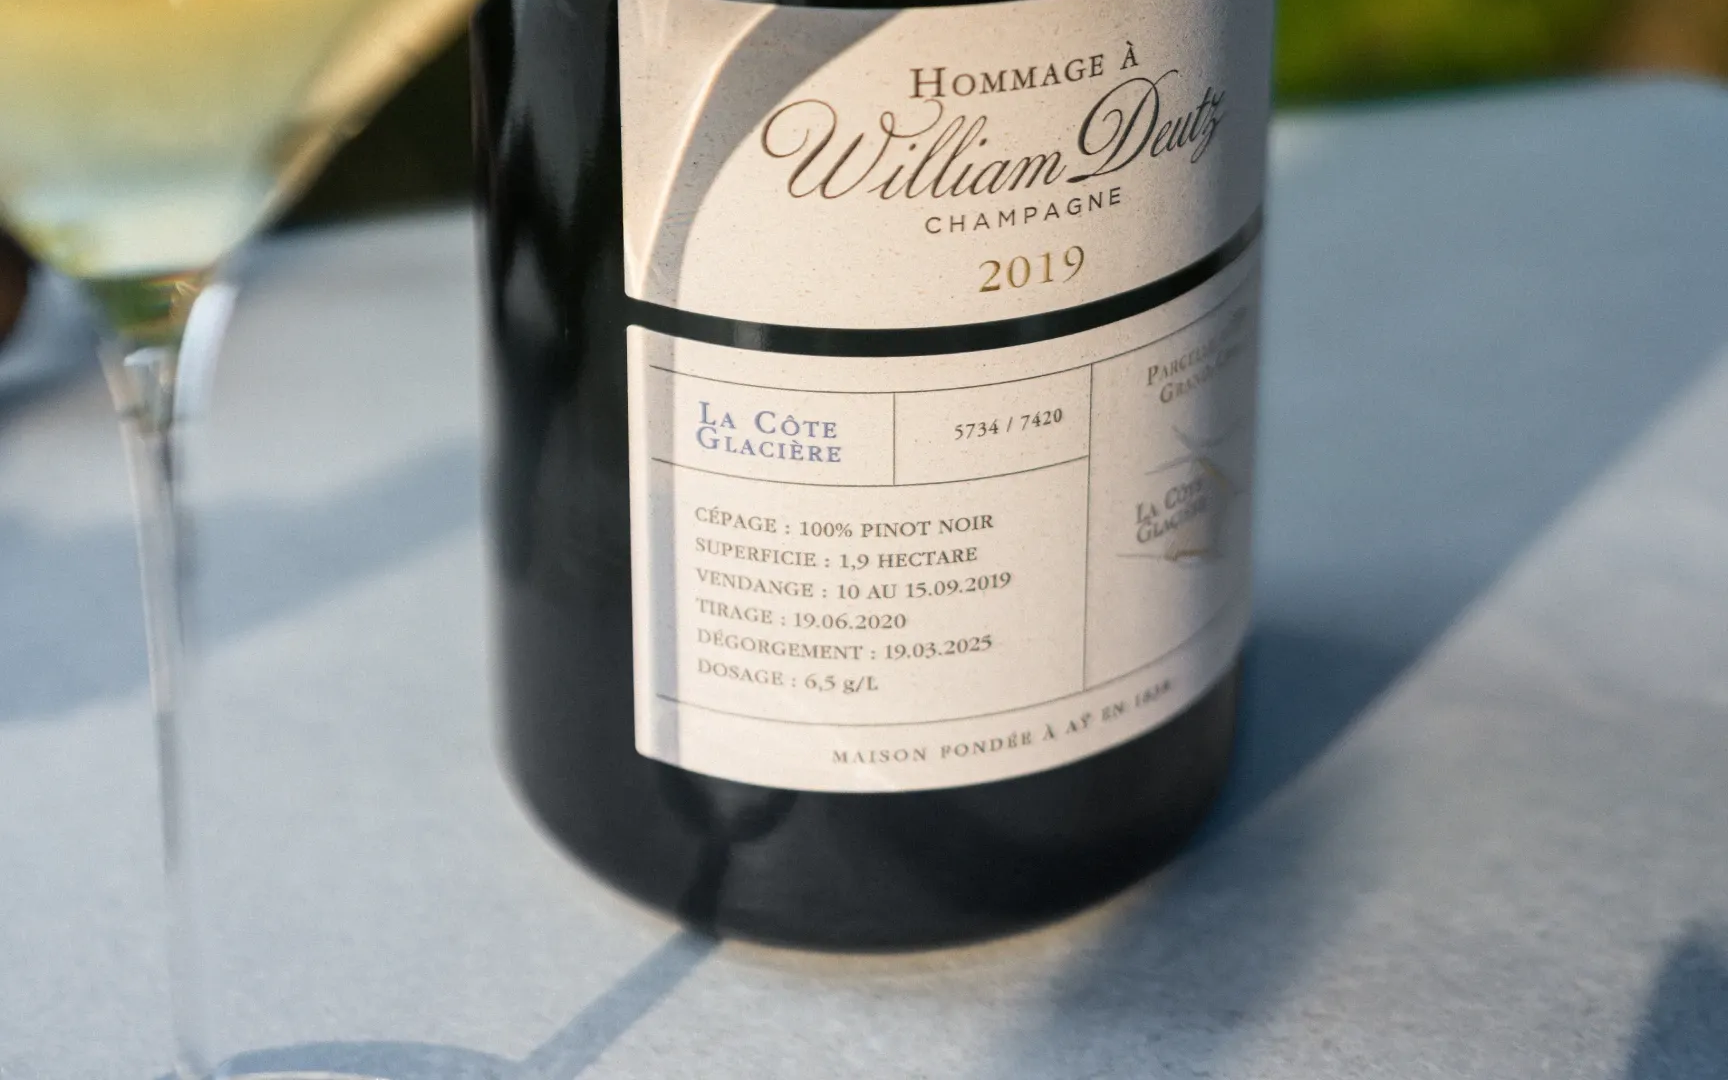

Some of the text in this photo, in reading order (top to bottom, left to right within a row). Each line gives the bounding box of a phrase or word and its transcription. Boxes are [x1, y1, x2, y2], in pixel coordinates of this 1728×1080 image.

[909, 40, 1140, 99] HOMMAGE À
[760, 69, 1226, 200] William Deutz
[925, 187, 1122, 234] CHAMPAGNE
[978, 244, 1085, 293] 2019
[699, 401, 838, 439] LA CÔTE
[954, 419, 999, 441] 5734
[1020, 408, 1064, 432] 7420
[695, 426, 842, 463] GLACIÈRE
[694, 506, 777, 534] CÉPAGE
[799, 522, 854, 539] 100%
[861, 522, 931, 539] PINOT
[938, 514, 994, 535] NOIR
[695, 537, 817, 567] SUPERFICIE
[839, 554, 870, 573] 1,9
[878, 547, 978, 570] HECTARE
[695, 568, 814, 598] VENDANGE
[838, 585, 860, 601] 10
[867, 583, 897, 600] AU
[906, 571, 1013, 599] 15.09.2019
[695, 597, 773, 625] TIRAGE
[794, 613, 907, 630] 19.06.2020
[696, 628, 864, 661] DÉGORGEMENT
[884, 635, 993, 661] 19.03.2025
[696, 658, 784, 687] DOSAGE
[804, 675, 836, 693] 6,5
[843, 675, 879, 694] g/L
[832, 748, 927, 764] MAISON
[940, 730, 1033, 759] FONDÉE
[1103, 701, 1125, 721] EN
